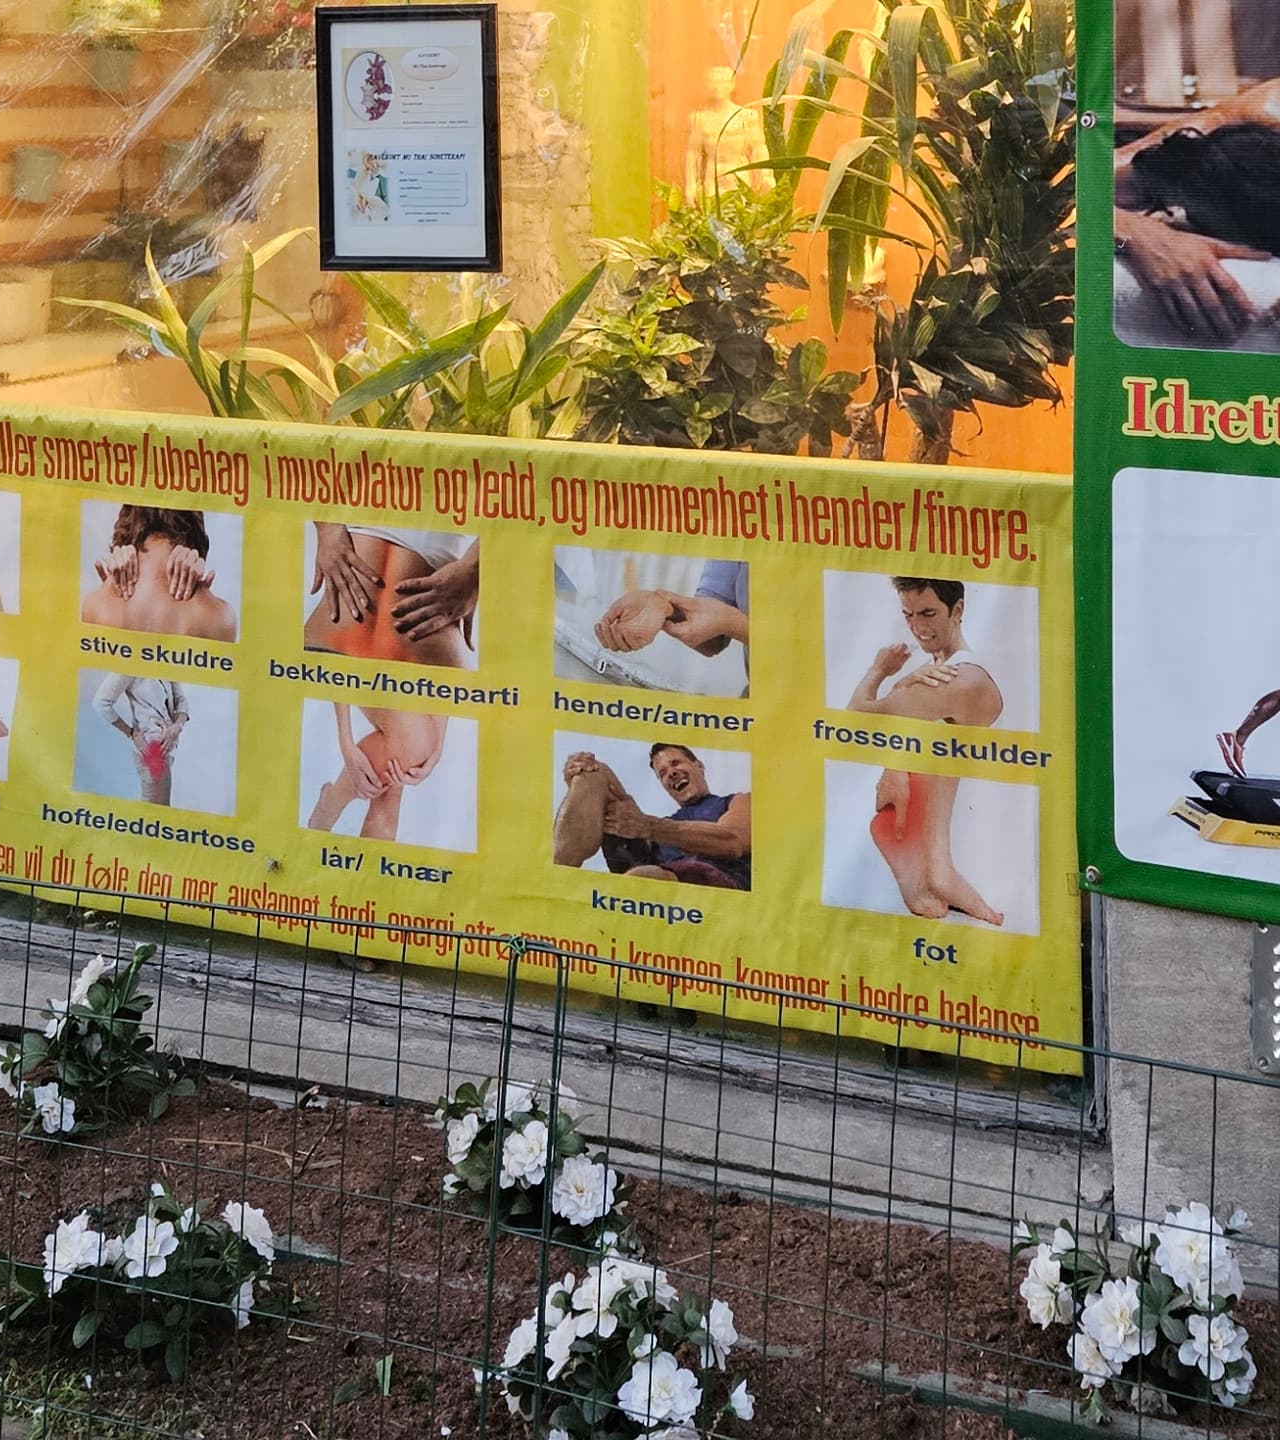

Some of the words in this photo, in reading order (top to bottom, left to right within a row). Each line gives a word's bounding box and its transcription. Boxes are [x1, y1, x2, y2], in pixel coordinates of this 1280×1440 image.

[263, 442, 272, 499] i
[278, 448, 425, 512] muskulatur
[434, 467, 467, 526] og
[473, 458, 545, 527] ledd,
[551, 475, 587, 537] og
[594, 475, 770, 541] nummenhet
[774, 479, 784, 542] i
[79, 635, 133, 658] stive
[141, 643, 233, 672] skuldre
[270, 659, 519, 706] bekken-/hofteparti
[554, 691, 754, 732] hender/armer
[813, 720, 921, 754] frossen
[931, 736, 1051, 768] skulder
[42, 803, 256, 854] hofteleddsartose
[24, 845, 43, 882] vil
[51, 848, 75, 886] du
[380, 856, 453, 883] knær
[592, 889, 704, 926] krampe
[912, 938, 958, 965] fot
